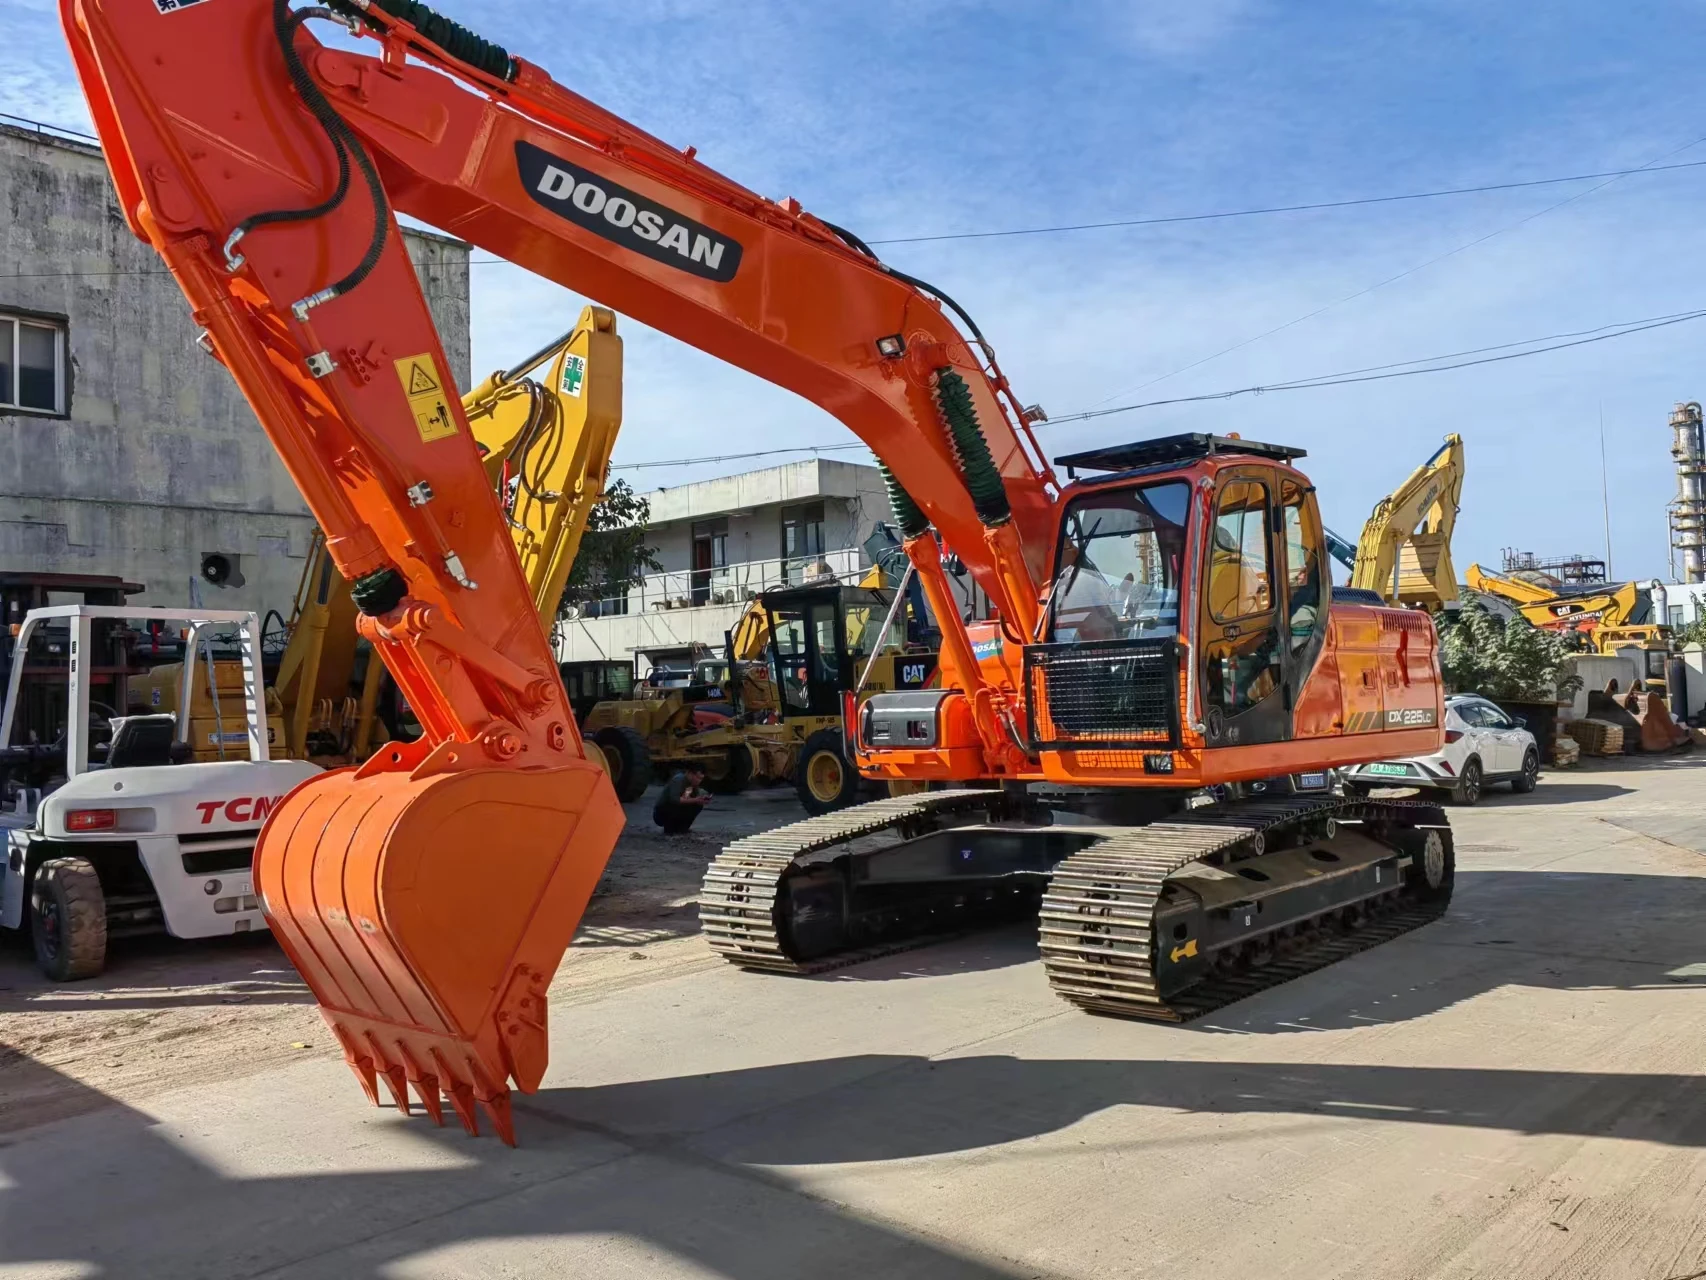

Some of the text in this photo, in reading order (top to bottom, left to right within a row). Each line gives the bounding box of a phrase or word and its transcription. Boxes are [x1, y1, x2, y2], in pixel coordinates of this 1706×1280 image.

[537, 164, 725, 270] DOOSAN
[1556, 605, 1571, 616] CAT
[903, 664, 925, 683] CAT
[196, 796, 285, 824] TCM
